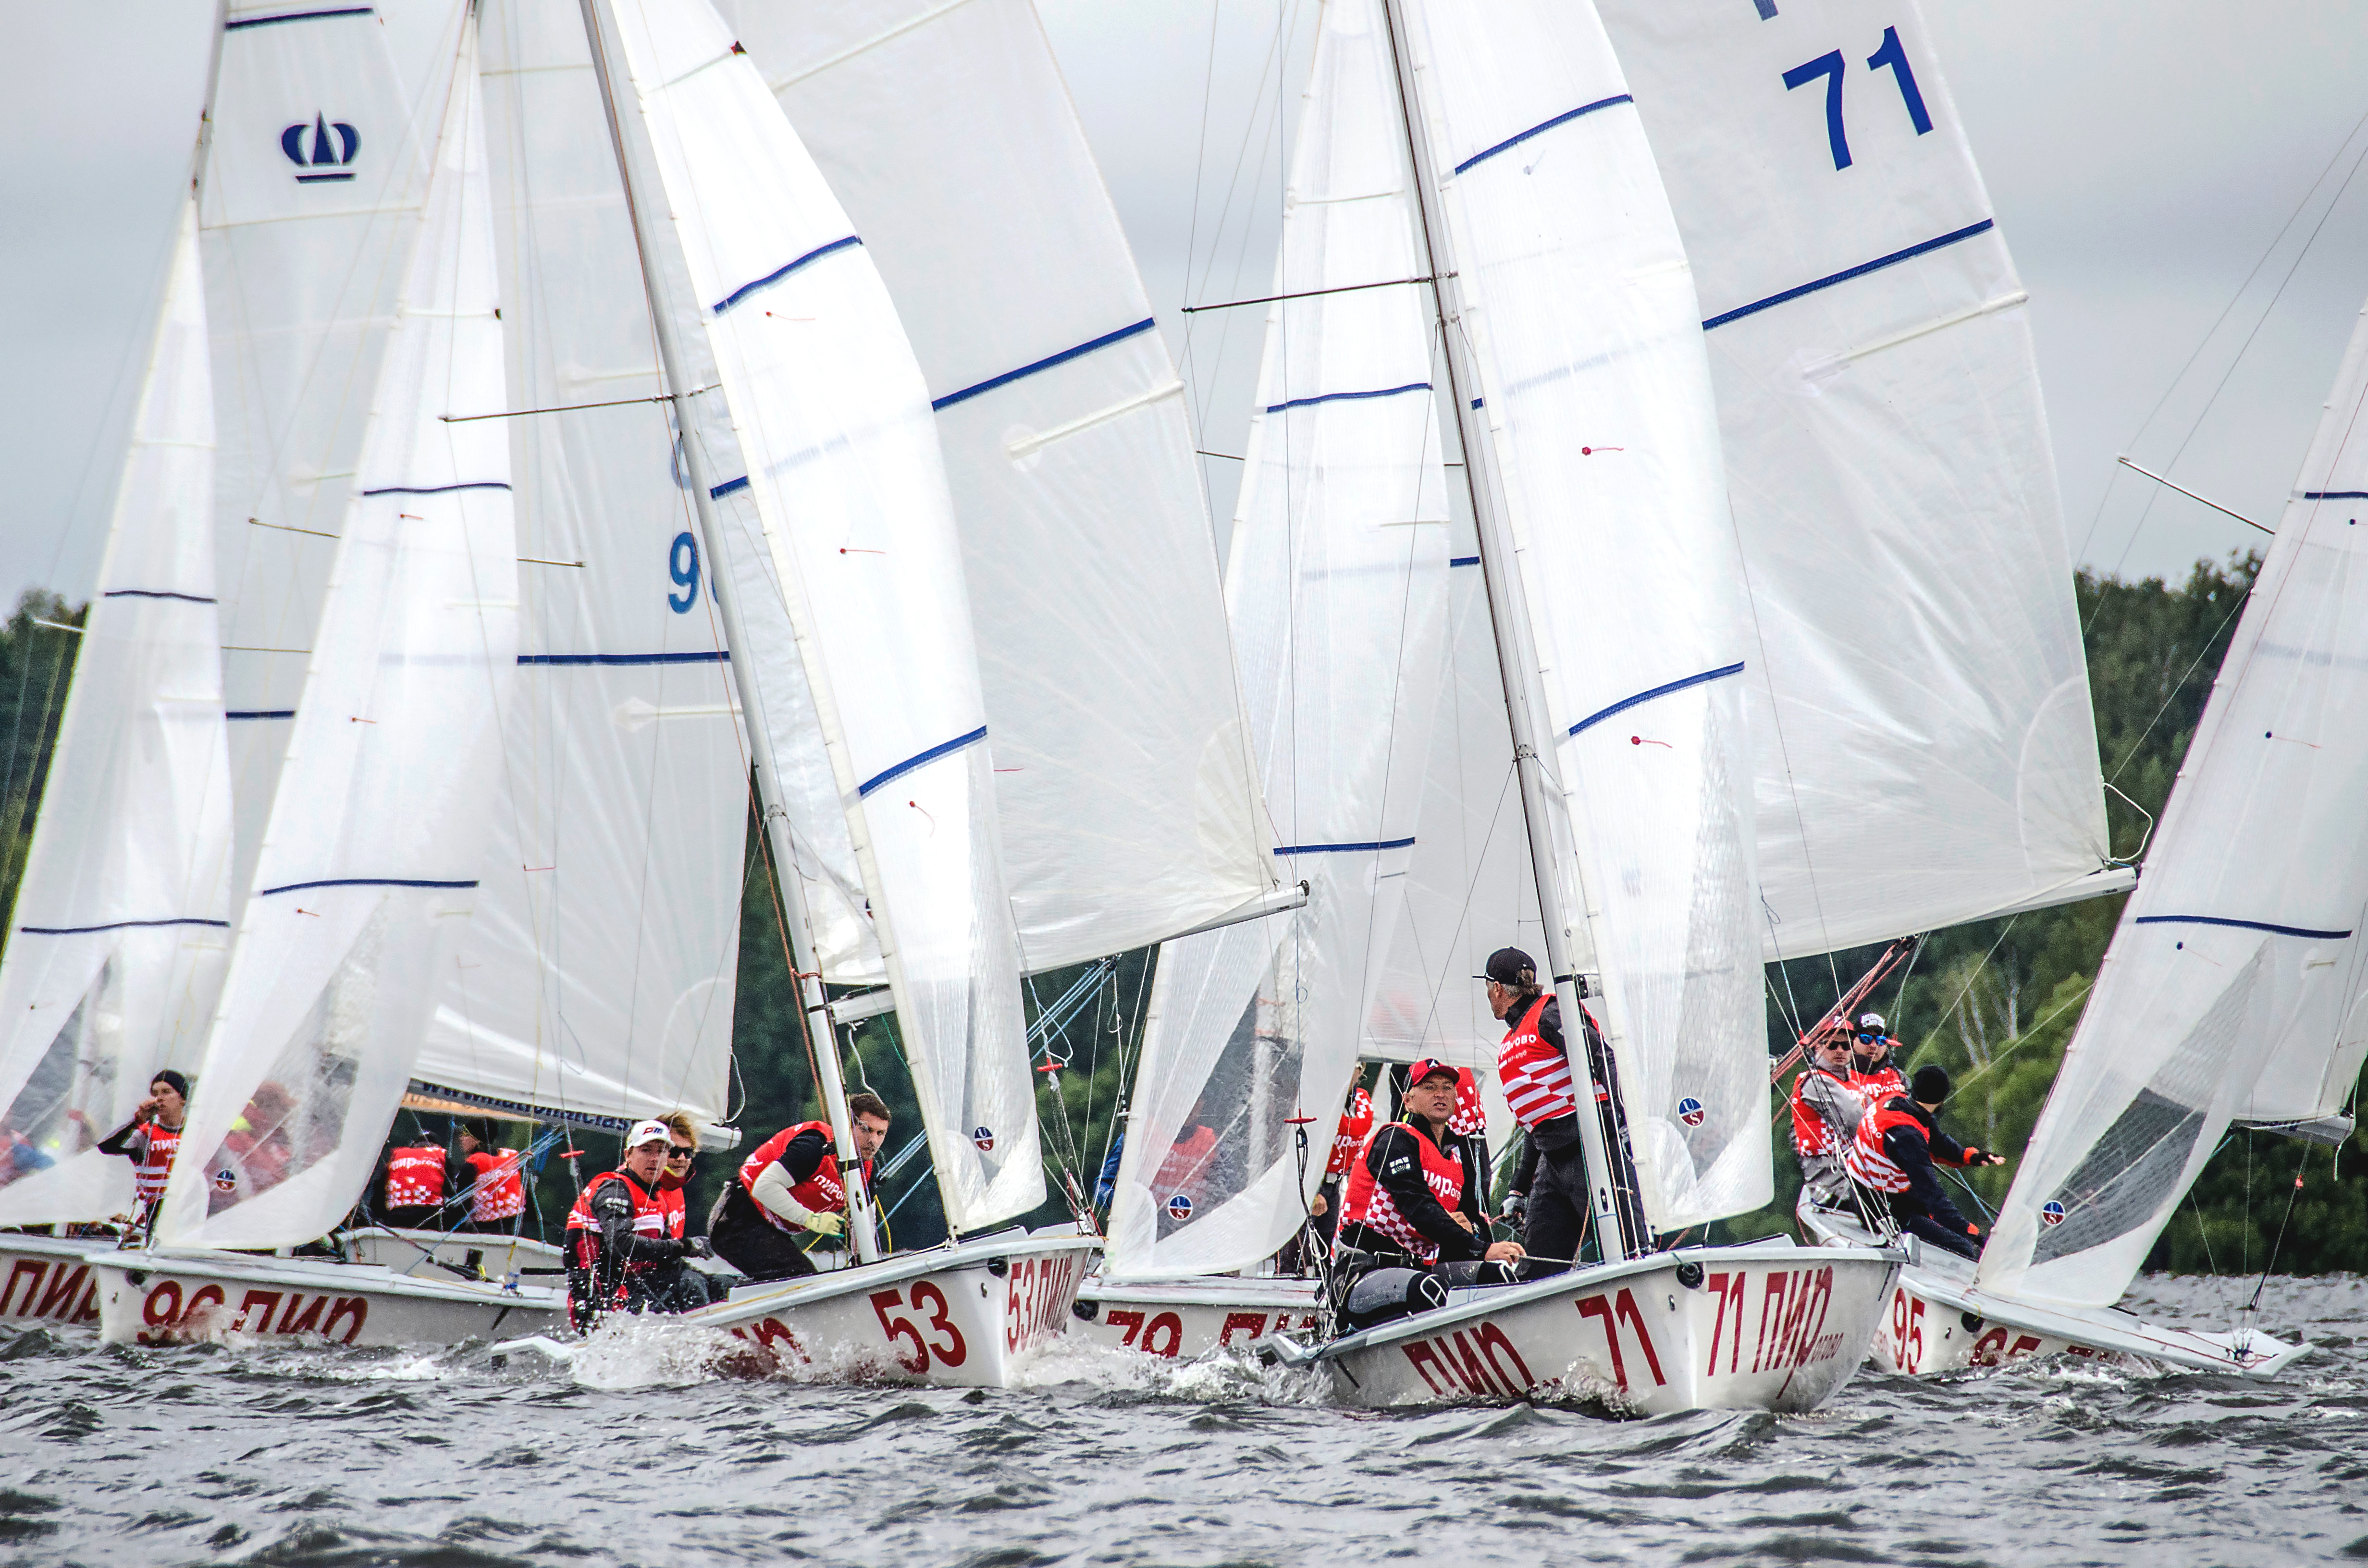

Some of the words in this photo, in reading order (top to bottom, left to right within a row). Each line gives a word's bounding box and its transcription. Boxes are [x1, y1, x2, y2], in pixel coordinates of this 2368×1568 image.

[1781, 25, 1934, 172] 71
[869, 1280, 966, 1374] 53
[1008, 1258, 1035, 1355] 53
[1575, 1287, 1667, 1393] 71
[1707, 1271, 1746, 1377] 71
[1893, 1287, 1925, 1375] 95
